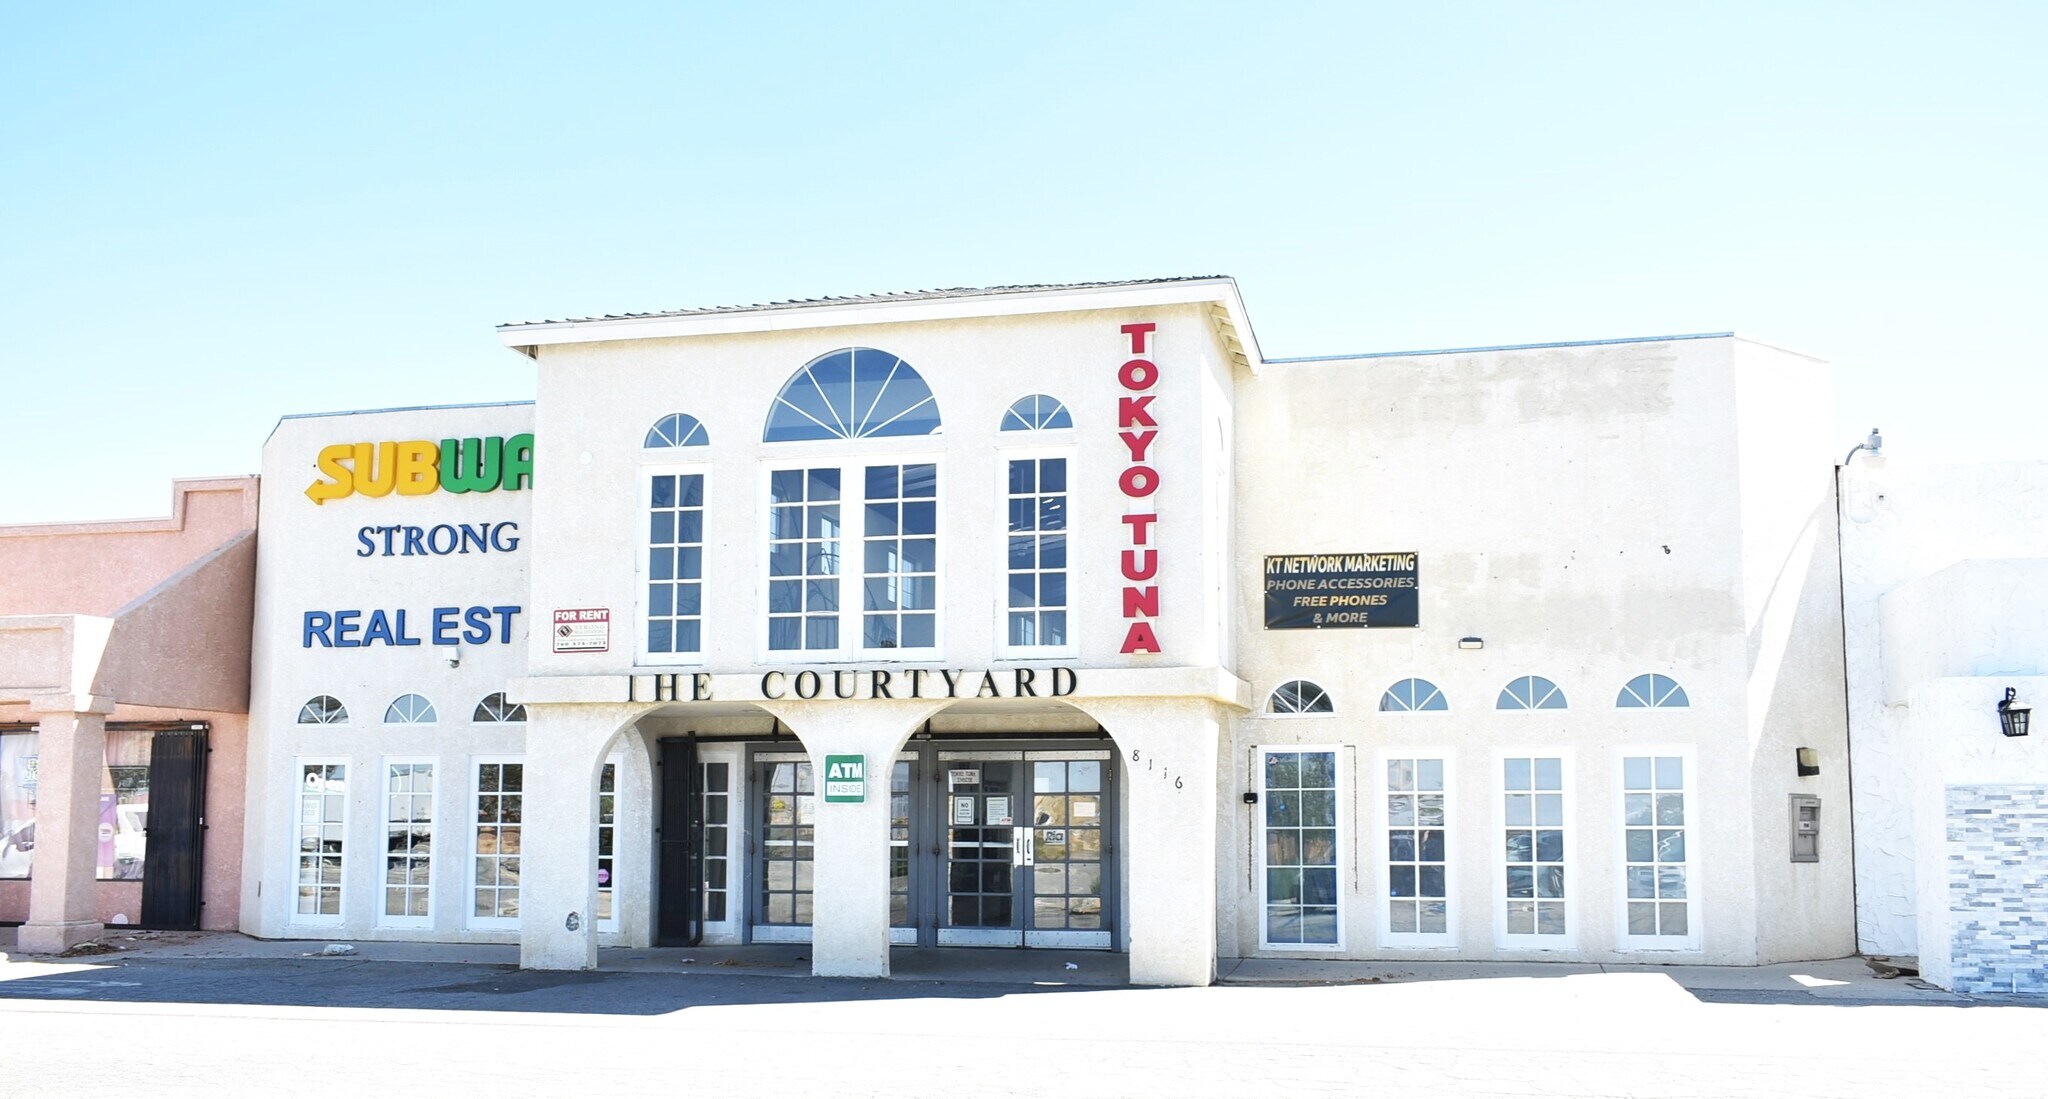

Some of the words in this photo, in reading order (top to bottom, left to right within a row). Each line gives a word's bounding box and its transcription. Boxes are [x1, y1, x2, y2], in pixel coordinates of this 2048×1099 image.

[1117, 322, 1159, 497] TOKYO
[356, 521, 521, 557] STRONG
[1266, 557, 1283, 574] KT
[1284, 556, 1343, 573] NETWORK
[1344, 554, 1415, 572] MARKETING
[1119, 513, 1161, 654] TUNA
[1266, 579, 1316, 590] PHONE
[1317, 577, 1415, 589] ACCESSORIES
[1293, 596, 1328, 607] FREE
[1329, 595, 1388, 606] PHONES
[555, 611, 577, 621] FOR
[579, 610, 608, 620] RENT
[1312, 613, 1323, 623] &
[1325, 612, 1369, 623] MORE
[303, 610, 421, 648] REAL
[761, 667, 1078, 700] COURTYARD
[828, 762, 863, 779] ATM
[829, 784, 861, 793] INSIDE
[1046, 831, 1064, 841] Ria
